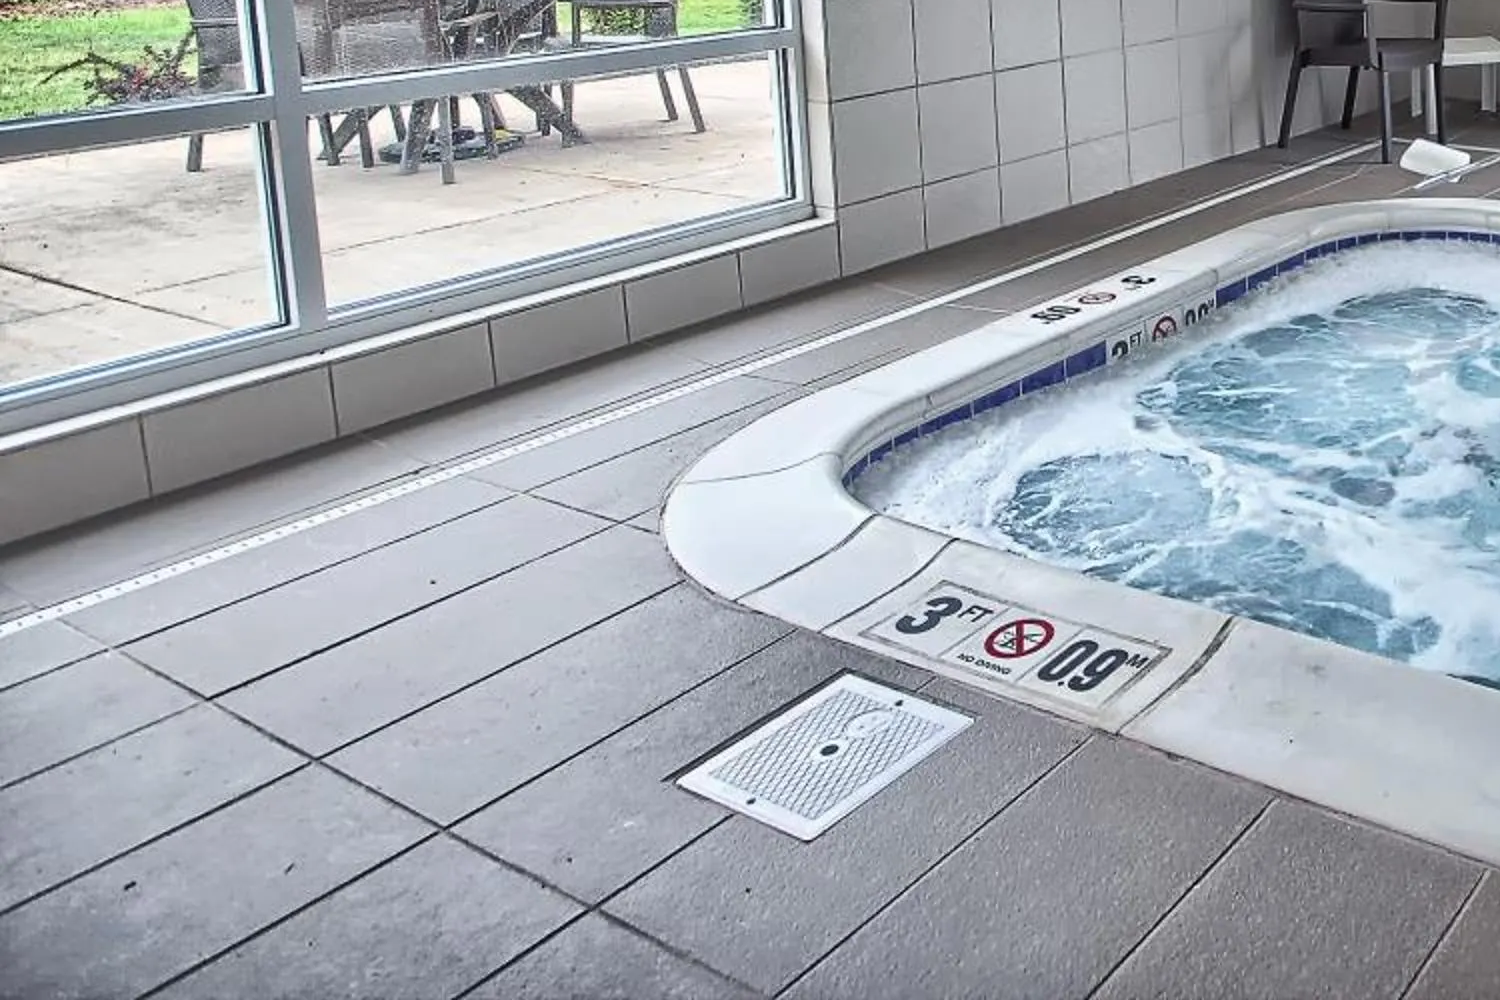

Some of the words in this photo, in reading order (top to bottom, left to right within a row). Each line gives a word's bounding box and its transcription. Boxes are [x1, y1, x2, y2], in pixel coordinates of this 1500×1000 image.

[895, 596, 963, 635] 3
[957, 604, 994, 623] FT
[1037, 639, 1129, 692] 0.9
[1124, 652, 1149, 669] M
